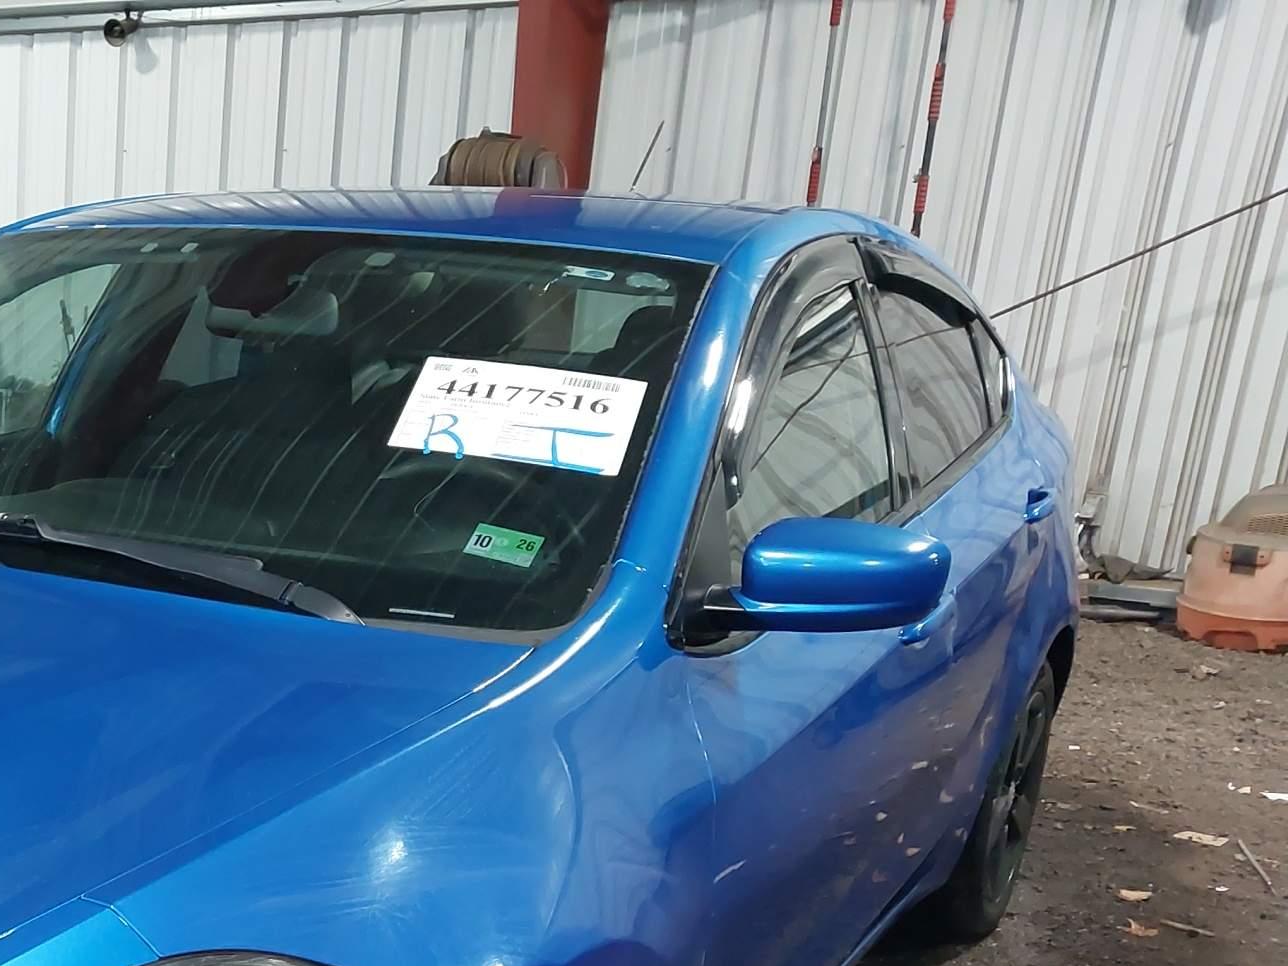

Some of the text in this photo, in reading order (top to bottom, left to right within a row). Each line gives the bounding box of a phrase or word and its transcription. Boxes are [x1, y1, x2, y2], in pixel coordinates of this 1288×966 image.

[436, 379, 611, 415] 44177516
[472, 533, 537, 552] 10 26
